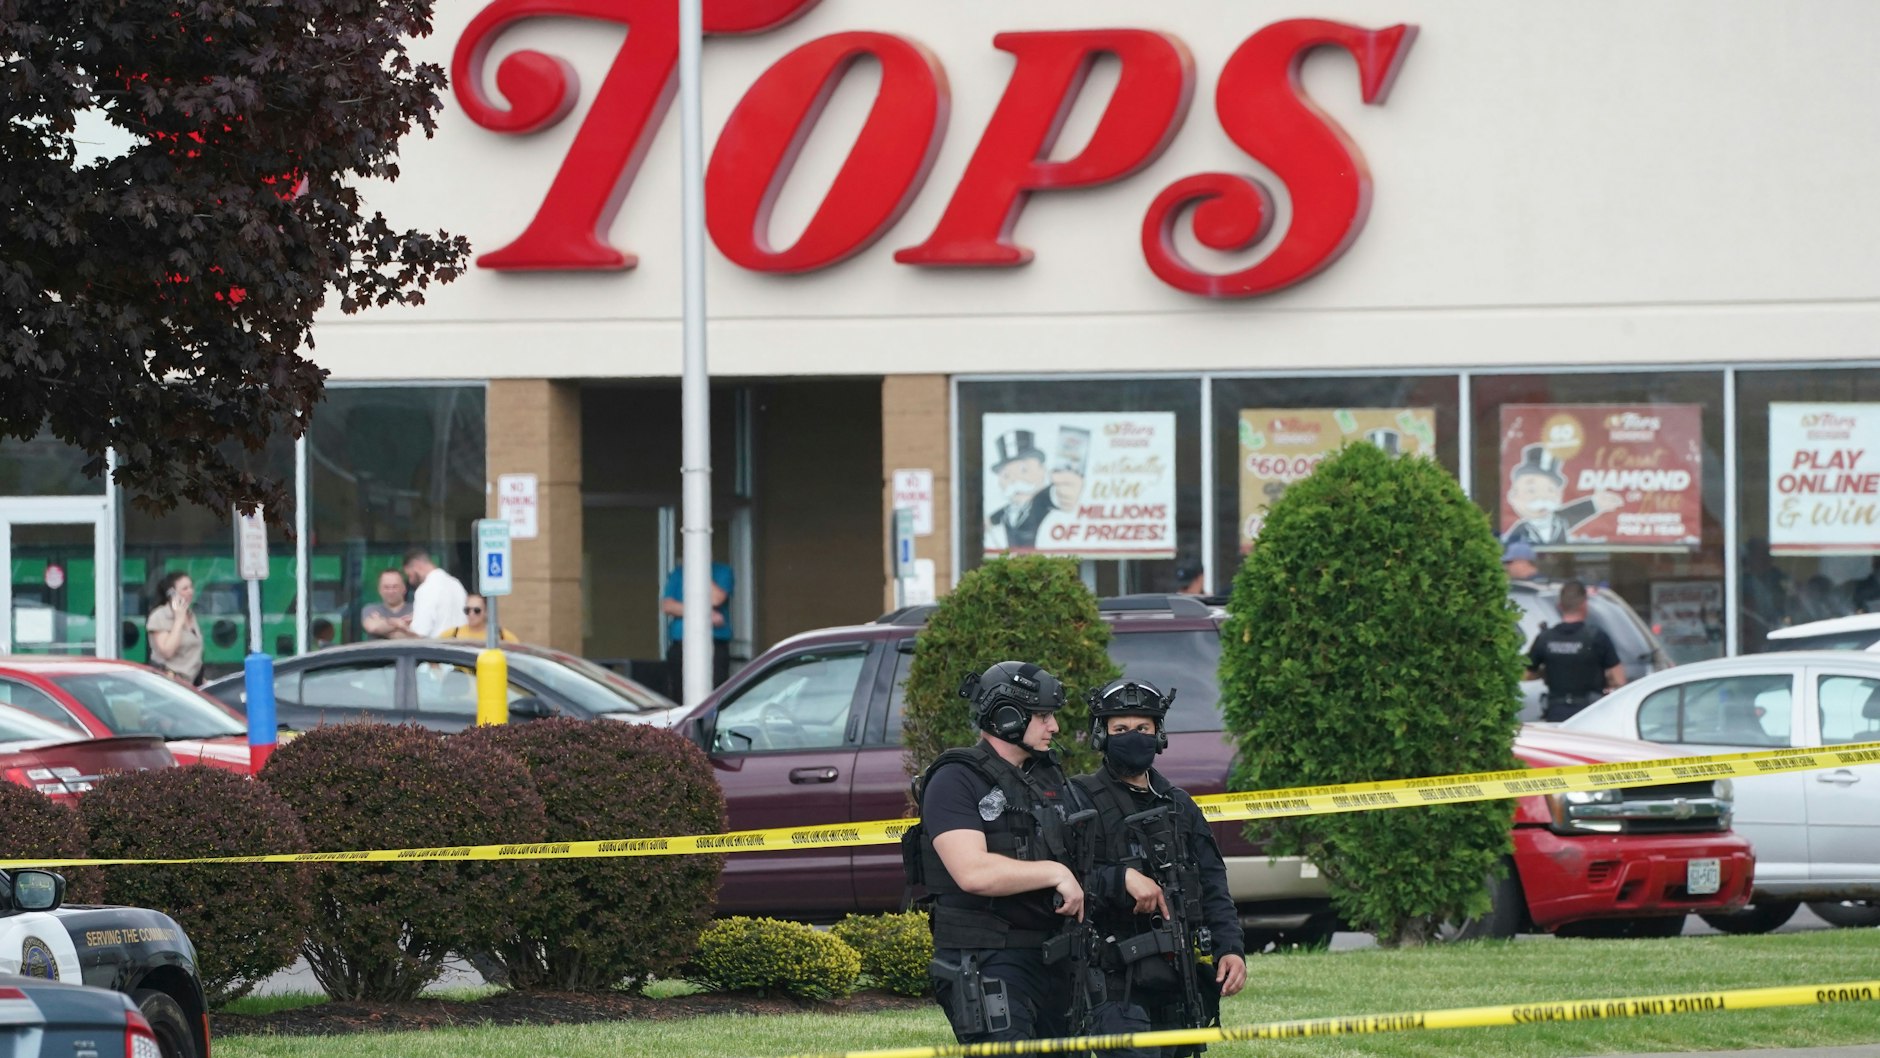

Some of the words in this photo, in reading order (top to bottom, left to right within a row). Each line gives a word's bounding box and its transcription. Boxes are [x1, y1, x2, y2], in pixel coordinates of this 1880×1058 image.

[1792, 449, 1865, 470] PLAY
[510, 482, 525, 493] NO
[1577, 468, 1691, 492] DIAMOND
[1777, 474, 1880, 494] ONLINE
[500, 495, 537, 506] PARKING
[1076, 504, 1167, 520] MILLIONS
[1050, 523, 1082, 541] OF
[1083, 524, 1167, 541] PRIZES!
[86, 929, 122, 947] SERVING
[121, 928, 140, 943] THE
